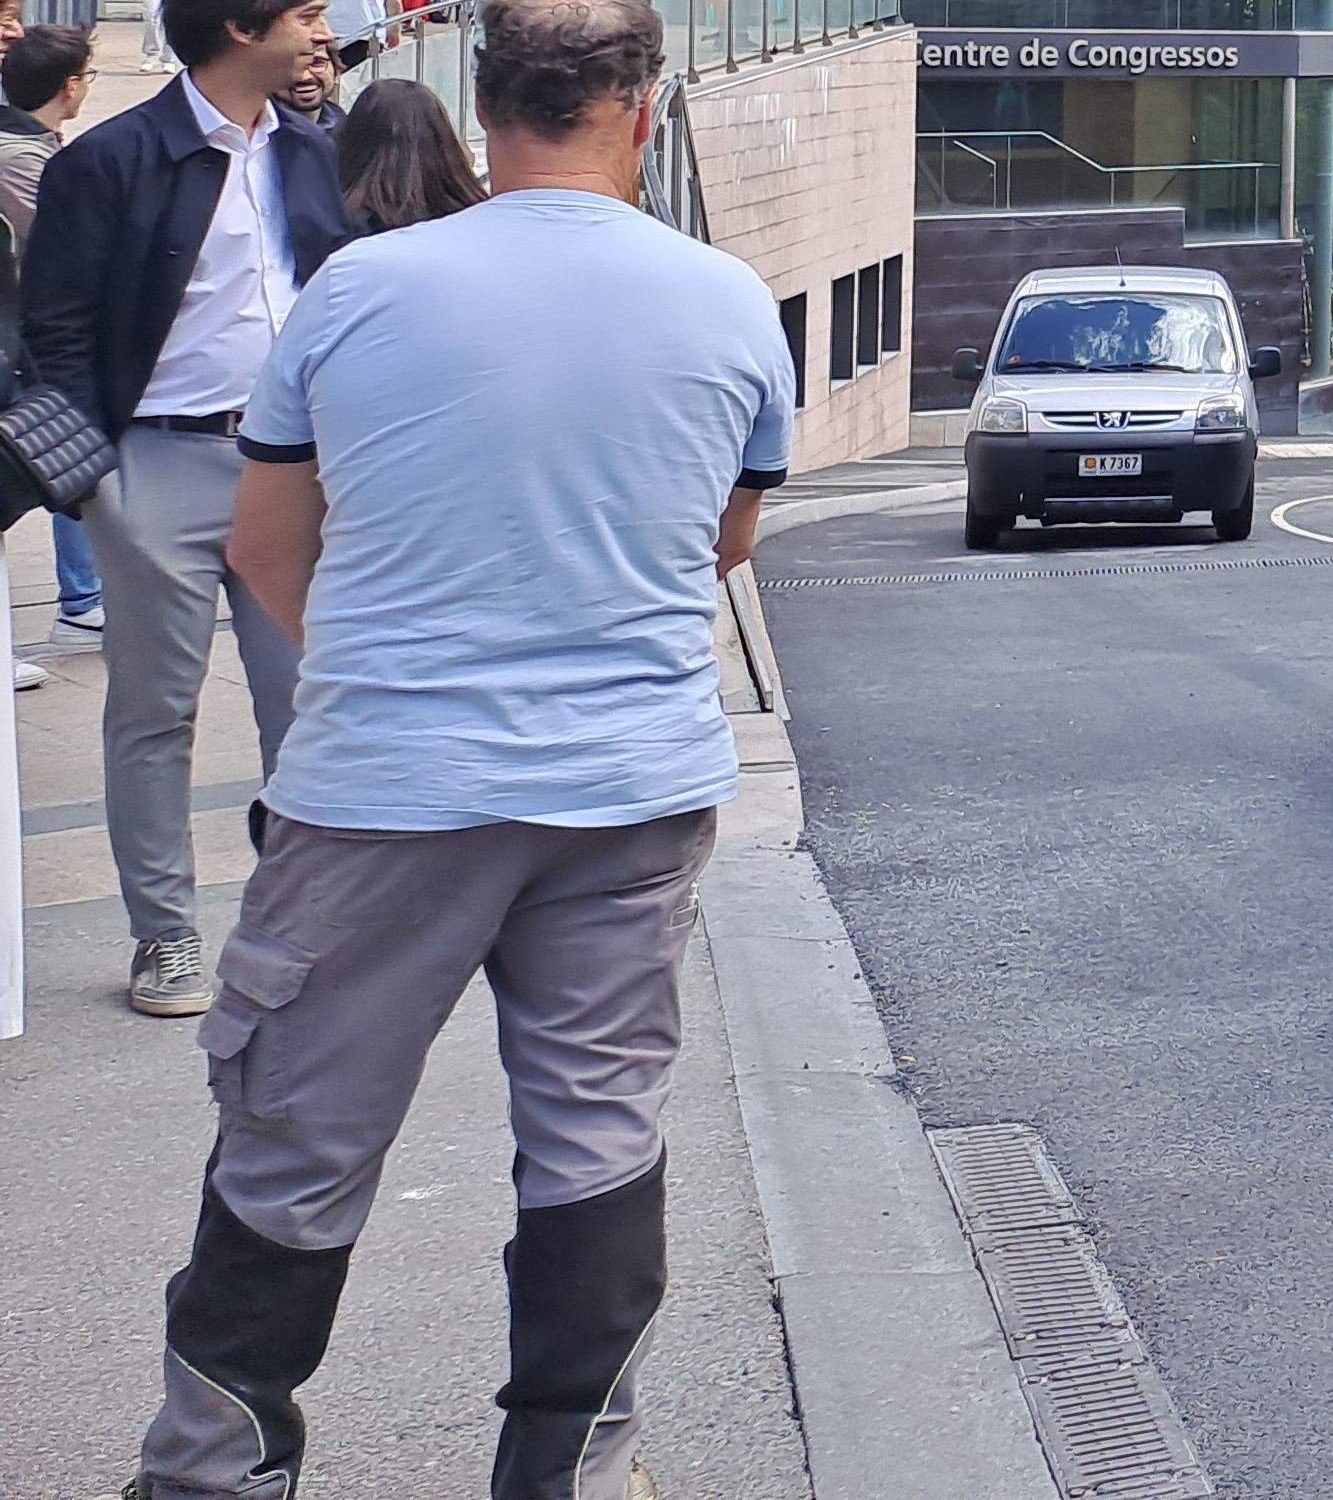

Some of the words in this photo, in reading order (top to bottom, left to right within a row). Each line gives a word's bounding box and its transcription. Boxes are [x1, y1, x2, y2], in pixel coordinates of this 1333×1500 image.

[915, 39, 1010, 67] entre
[1019, 38, 1060, 67] de
[1068, 39, 1239, 74] Congressos
[1100, 457, 1107, 470] K
